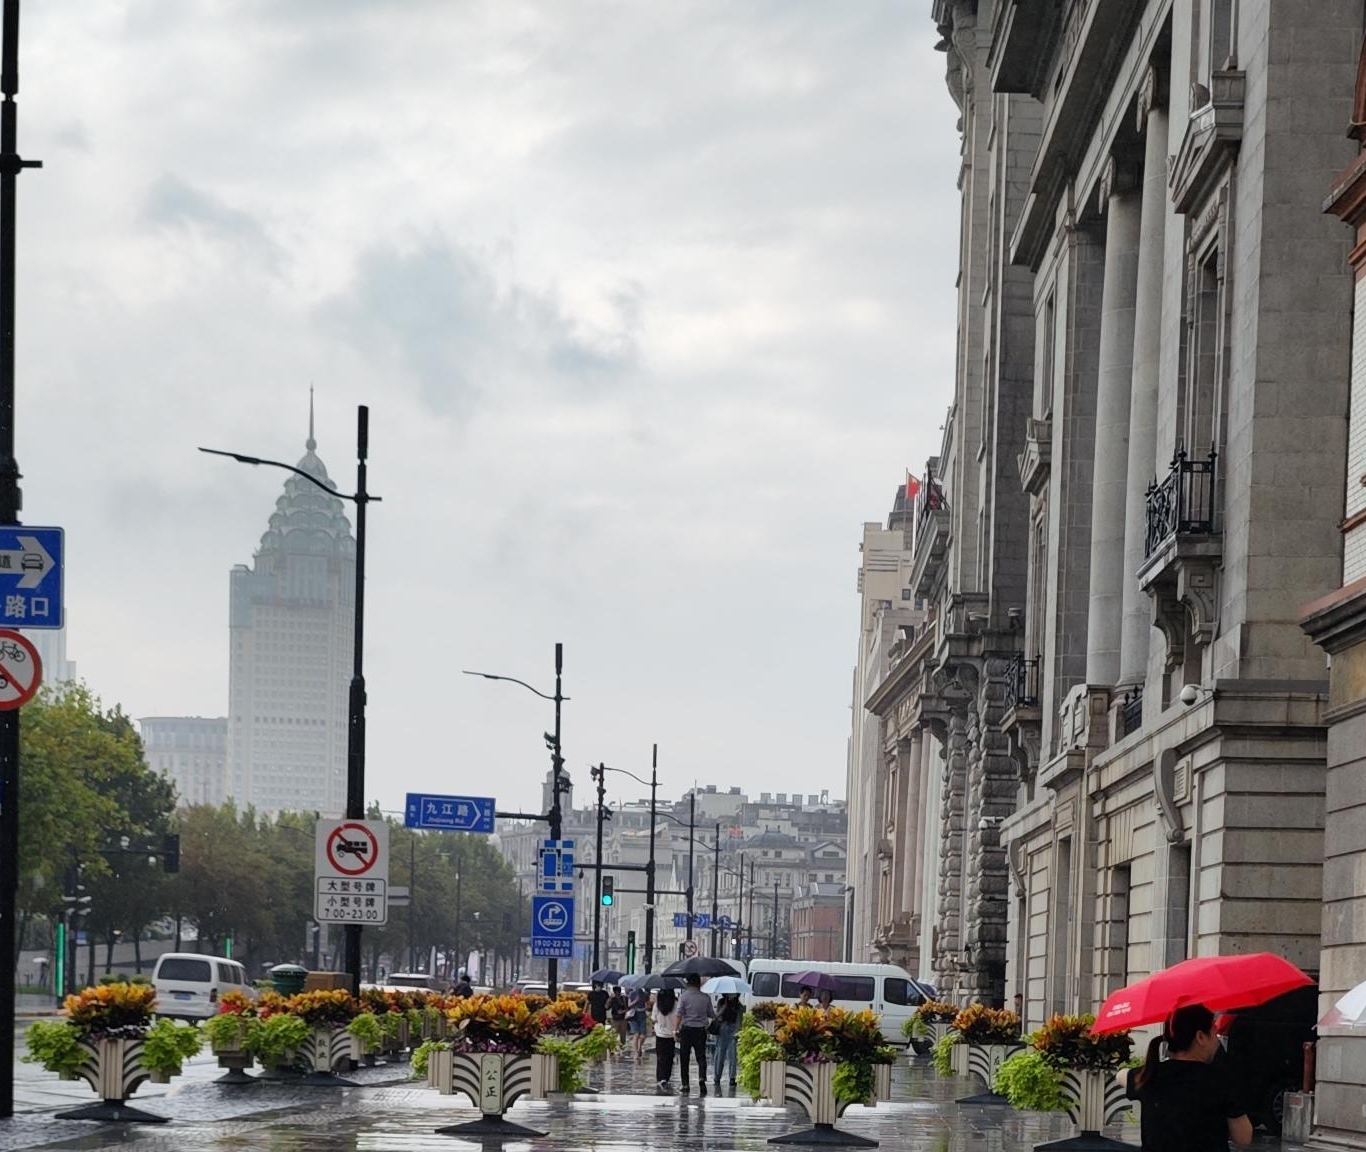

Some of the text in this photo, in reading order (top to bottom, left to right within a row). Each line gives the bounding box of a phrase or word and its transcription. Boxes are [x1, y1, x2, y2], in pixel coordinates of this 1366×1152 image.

[426, 802, 469, 817] 九江路
[327, 880, 375, 892] 大型号牌
[327, 895, 375, 908] 小型号牌
[324, 907, 378, 919] 700-2300
[485, 1070, 498, 1097] 公正
